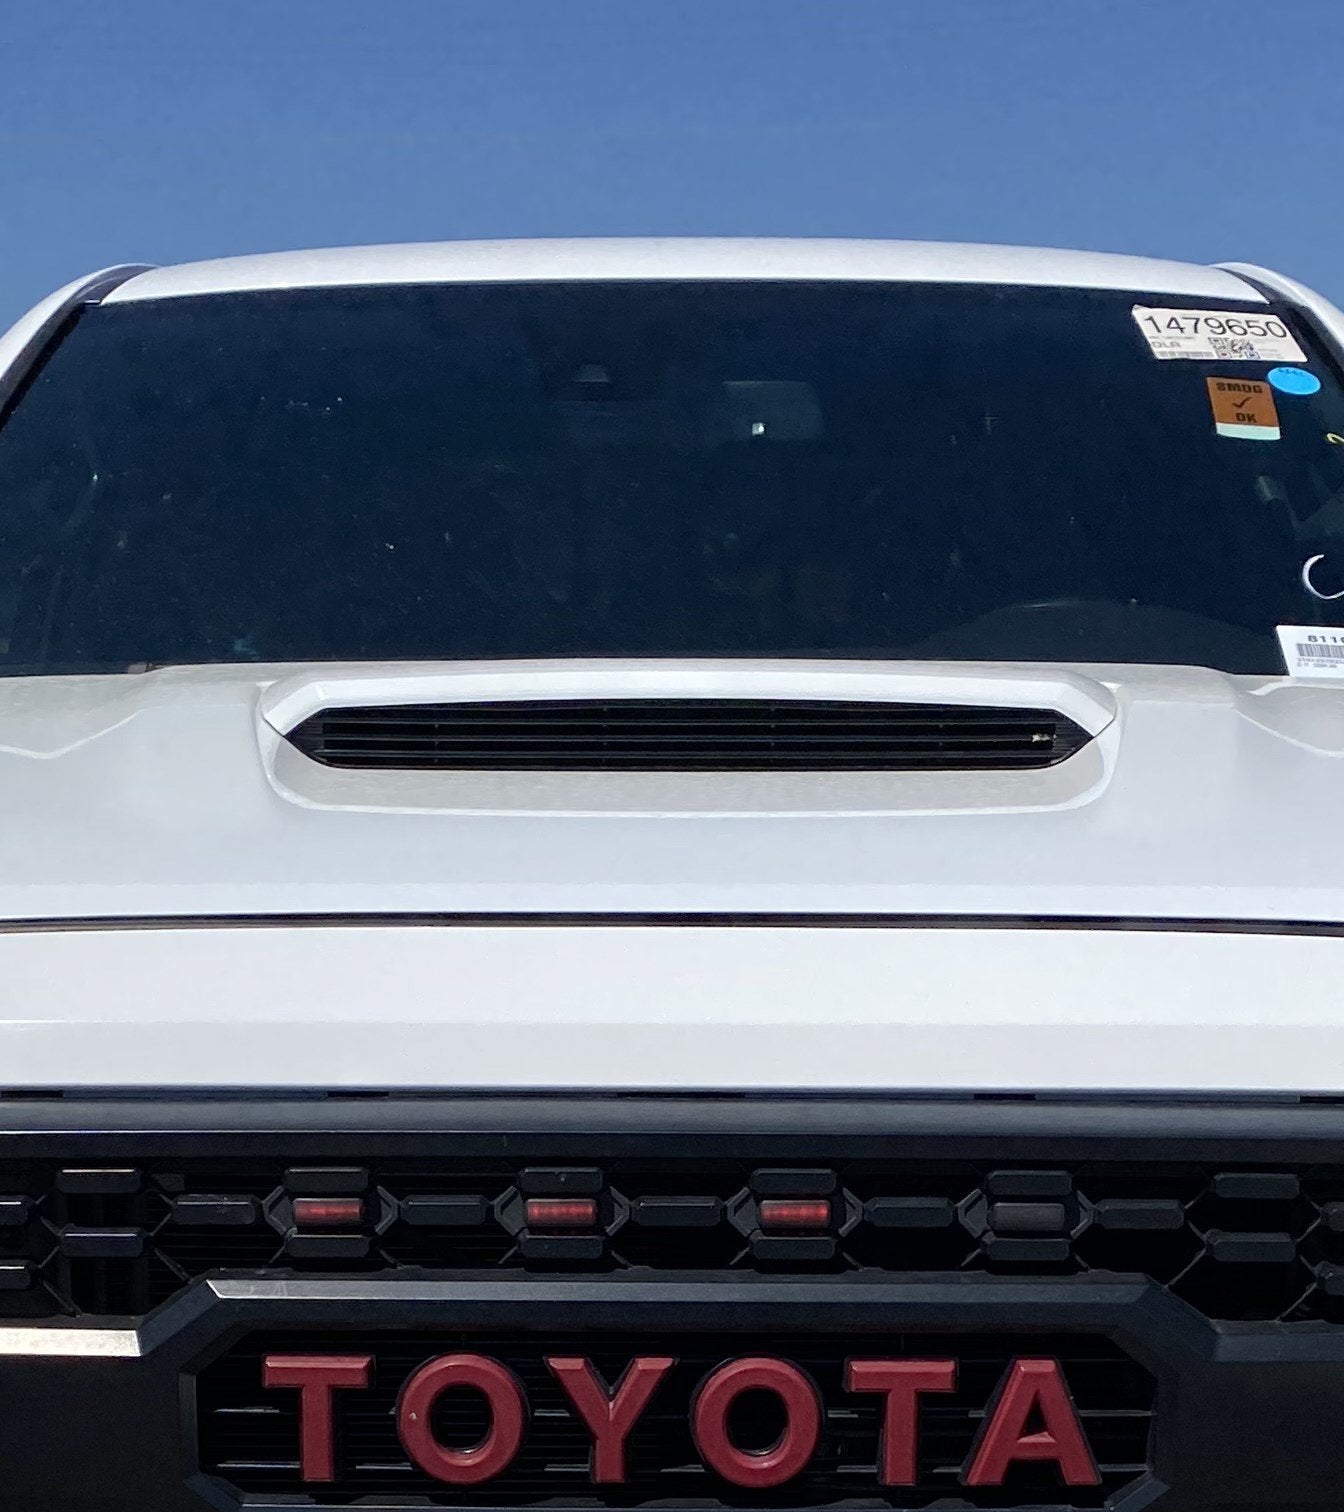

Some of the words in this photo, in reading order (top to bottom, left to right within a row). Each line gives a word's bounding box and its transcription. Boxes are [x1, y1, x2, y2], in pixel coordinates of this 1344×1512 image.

[1144, 315, 1288, 338] 1479650
[1216, 382, 1264, 394] SMOG
[1235, 412, 1258, 423] OK
[261, 1352, 1104, 1488] TOYOTA
